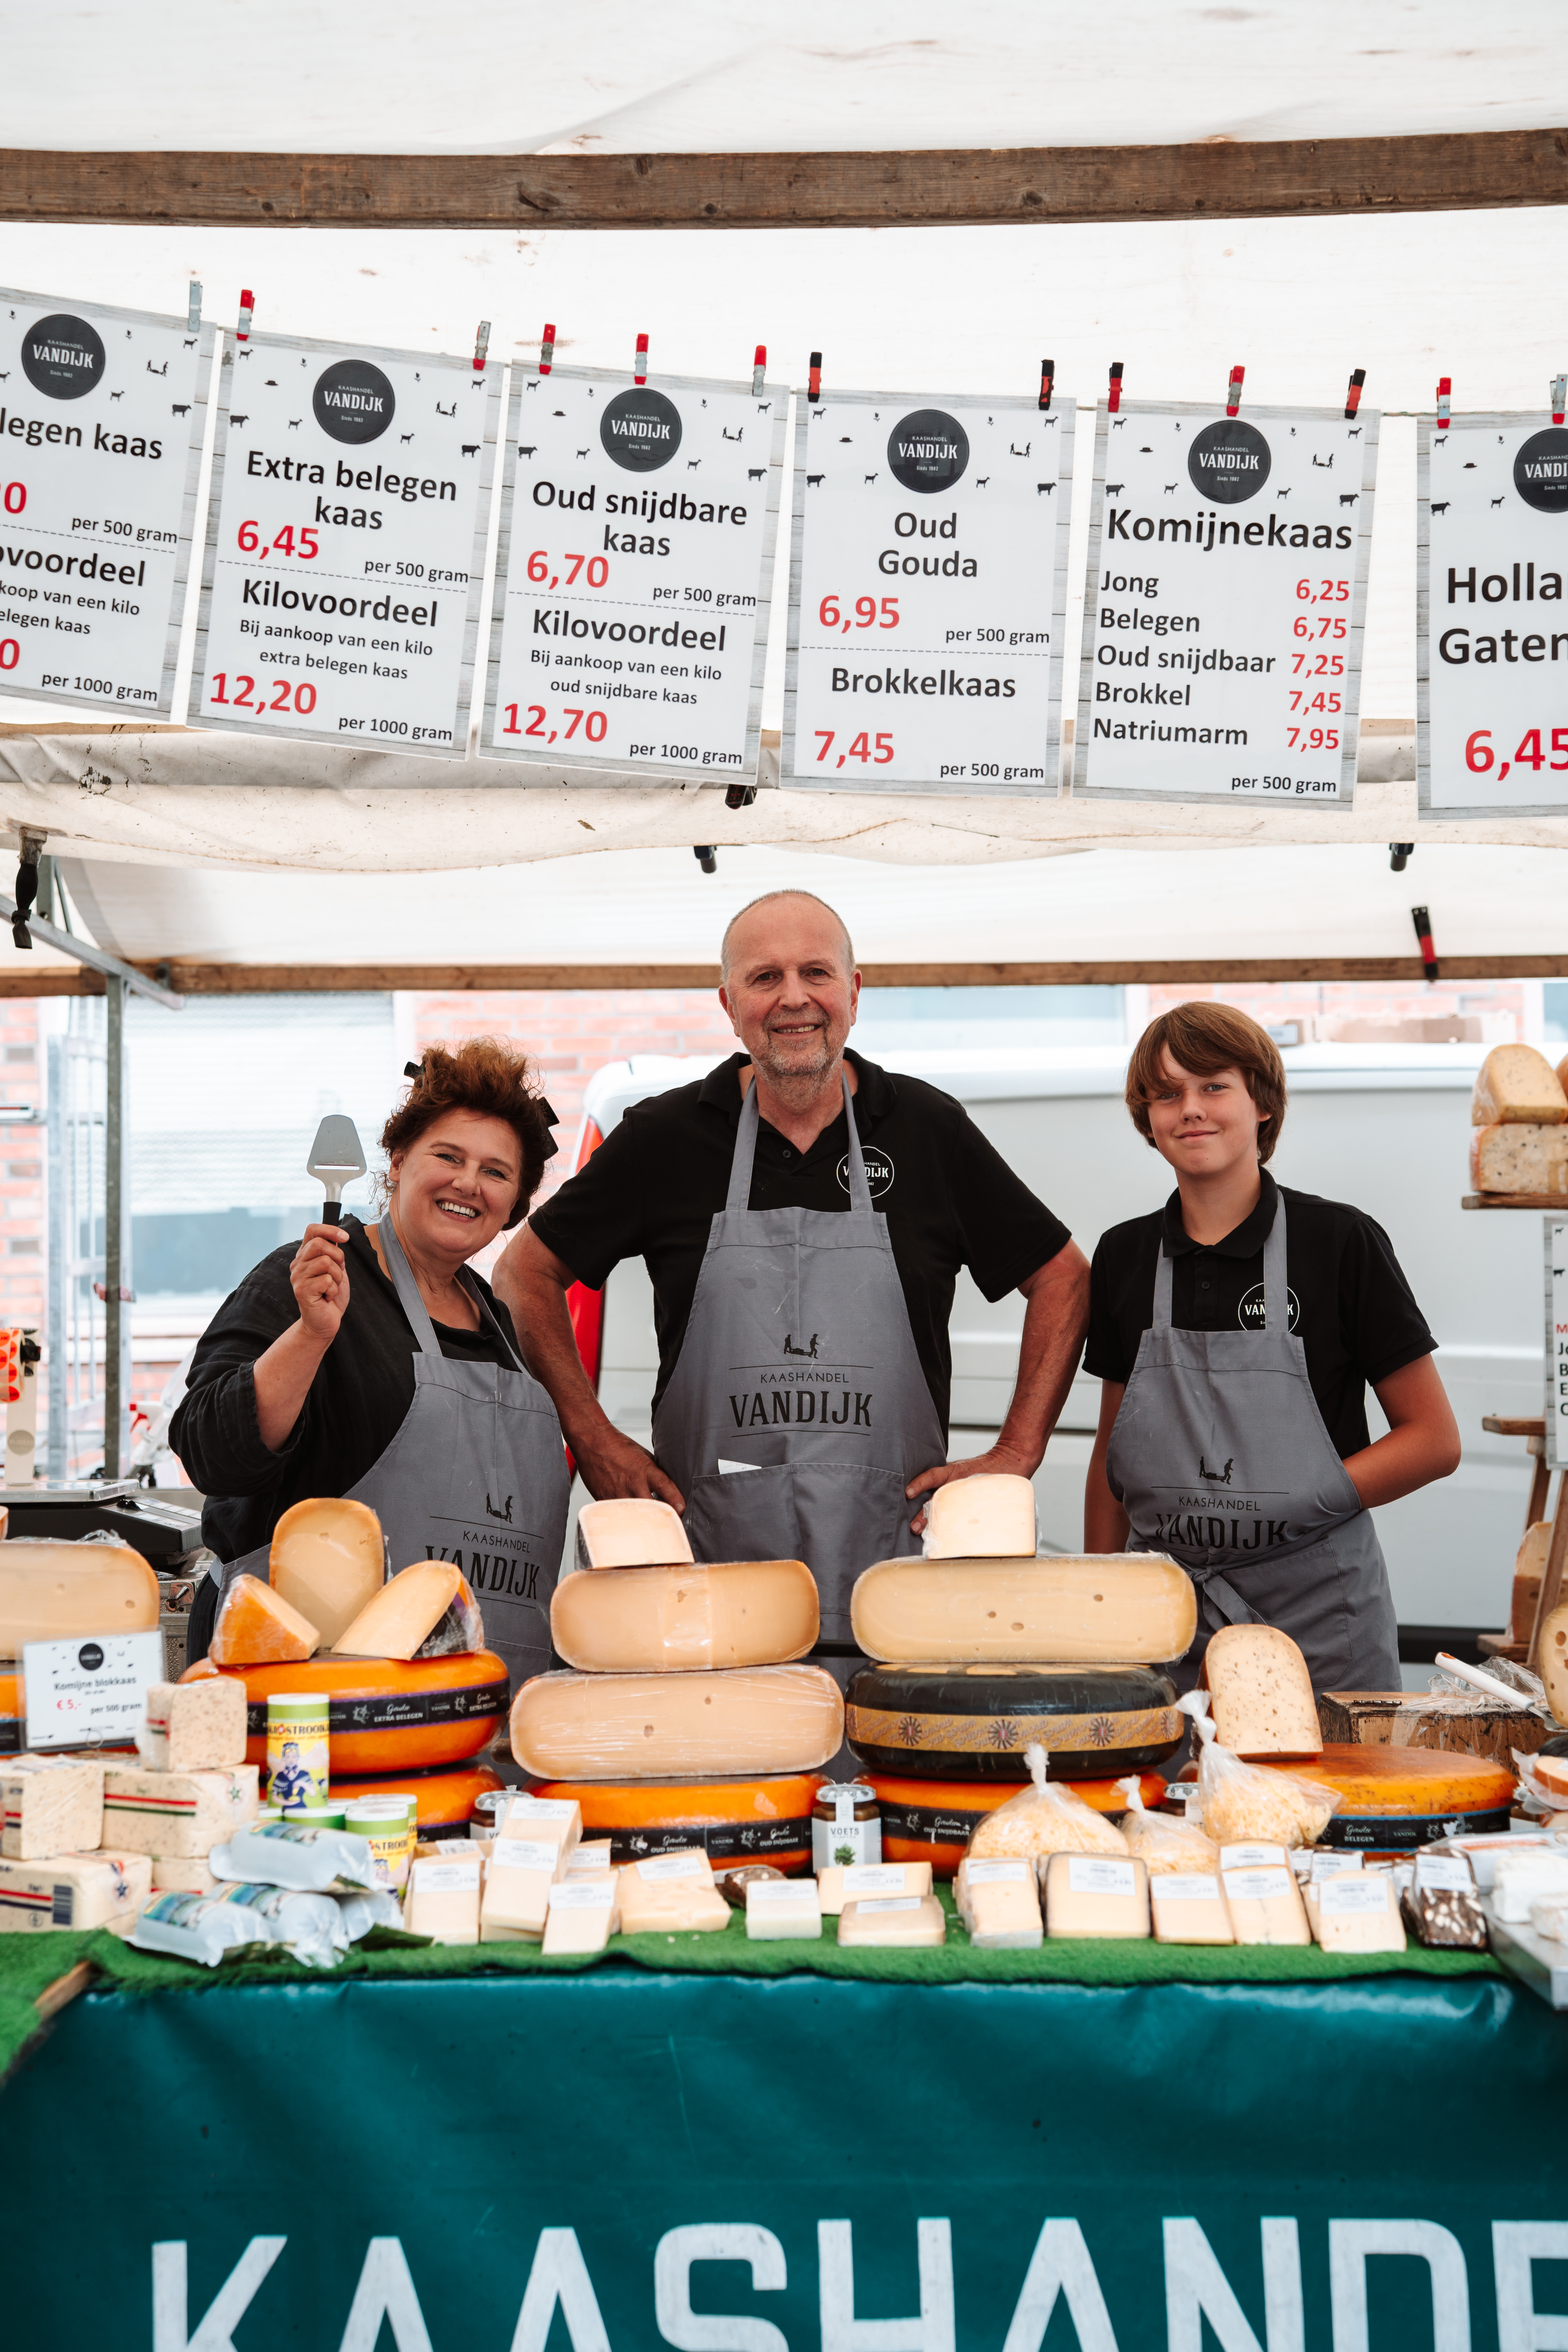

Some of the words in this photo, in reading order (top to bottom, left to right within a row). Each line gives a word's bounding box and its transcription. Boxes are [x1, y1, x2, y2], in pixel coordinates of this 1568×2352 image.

[32, 343, 94, 369] VANDIJK
[47, 338, 84, 350] KAASHANDEL
[324, 390, 384, 413] VANDIJK
[338, 385, 374, 395] KAASHANDEL
[611, 419, 670, 440] VANDIJK
[626, 414, 661, 422] KAASHANDEL
[94, 423, 162, 459] kaas
[898, 443, 958, 459] VANDIJK
[1199, 453, 1259, 470] VANDIJK
[248, 451, 324, 484] Extra
[336, 460, 456, 502] belegen
[315, 496, 382, 529] kaas
[533, 481, 595, 511] Oud
[605, 491, 747, 525] snijdbare
[72, 518, 99, 531] per
[103, 520, 132, 536] 500
[136, 528, 177, 543] gram
[894, 512, 957, 538] Oud
[1108, 509, 1351, 551] Komijnekaas
[238, 520, 319, 560] 6,45
[604, 525, 670, 556] kaas
[365, 561, 391, 574] per
[396, 562, 424, 577] 500
[428, 569, 468, 583] gram
[527, 551, 609, 590] 6,70
[878, 550, 977, 577] Gouda
[1101, 571, 1159, 598] Jong
[1296, 579, 1349, 604] 6,25
[1448, 562, 1568, 604] Holla
[43, 591, 71, 604] van
[77, 597, 106, 610] een
[112, 598, 139, 615] kilo
[242, 579, 438, 627] Kilovoordeel
[653, 588, 679, 600] per
[684, 588, 712, 602] 500
[716, 594, 756, 606] gram
[55, 616, 90, 634] kaas
[819, 595, 899, 633] 6,95
[1101, 608, 1200, 636] Belegen
[1294, 616, 1346, 641] 6,75
[241, 620, 260, 637] Bij
[265, 626, 333, 646] aankoop
[338, 635, 365, 647] van
[371, 639, 399, 651] een
[405, 639, 432, 655] kilo
[533, 609, 726, 651] Kilovoordeel
[946, 630, 972, 643] per
[977, 629, 1005, 642] 500
[1010, 633, 1049, 645] gram
[260, 652, 300, 665] extra
[306, 653, 367, 675] belegen
[373, 662, 407, 679] kaas
[531, 650, 550, 667] Bij
[555, 654, 622, 673] aankoop
[628, 662, 655, 674] van
[661, 665, 688, 677] een
[694, 665, 721, 680] kilo
[1098, 645, 1149, 667] Oud
[1158, 648, 1276, 674] snijdbaar
[1292, 653, 1344, 679] 7,25
[42, 675, 69, 687] per
[74, 677, 112, 694] 1000
[116, 687, 157, 701] gram
[211, 673, 316, 715] 12,20
[551, 680, 580, 693] oud
[585, 683, 657, 700] snijdbare
[663, 688, 697, 704] kaas
[832, 668, 1015, 697] Brokkelkaas
[1096, 682, 1190, 705] Brokkel
[1289, 691, 1341, 716] 7,45
[339, 718, 365, 730] per
[371, 719, 408, 735] 1000
[412, 727, 452, 740] gram
[503, 703, 607, 744] 12,70
[1094, 718, 1247, 745] Natriumarm
[1287, 727, 1339, 752] 7,95
[630, 745, 656, 757] per
[661, 745, 698, 760] 1000
[702, 752, 742, 764] gram
[815, 731, 894, 768] 7,45
[941, 765, 966, 778] per
[971, 763, 999, 776] 500
[1004, 768, 1043, 780] gram
[1232, 778, 1258, 790] per
[1263, 776, 1291, 790] 500
[1296, 781, 1336, 794] gram
[843, 1166, 889, 1178] VDIJK
[1244, 1304, 1294, 1315] VANK
[760, 1372, 849, 1384] KAASHANDEL
[729, 1391, 872, 1428] VANDIJK
[1178, 1496, 1261, 1511] KAASHANDEL
[463, 1530, 530, 1553] KAASHANDEL
[1156, 1513, 1289, 1550] VANDIJK
[54, 1679, 92, 1691] Komijne
[95, 1676, 137, 1687] blokkaas
[56, 1700, 63, 1710] €
[90, 1706, 104, 1715] per
[374, 1714, 395, 1723] EXTRA
[396, 1712, 423, 1721] BELEGEN
